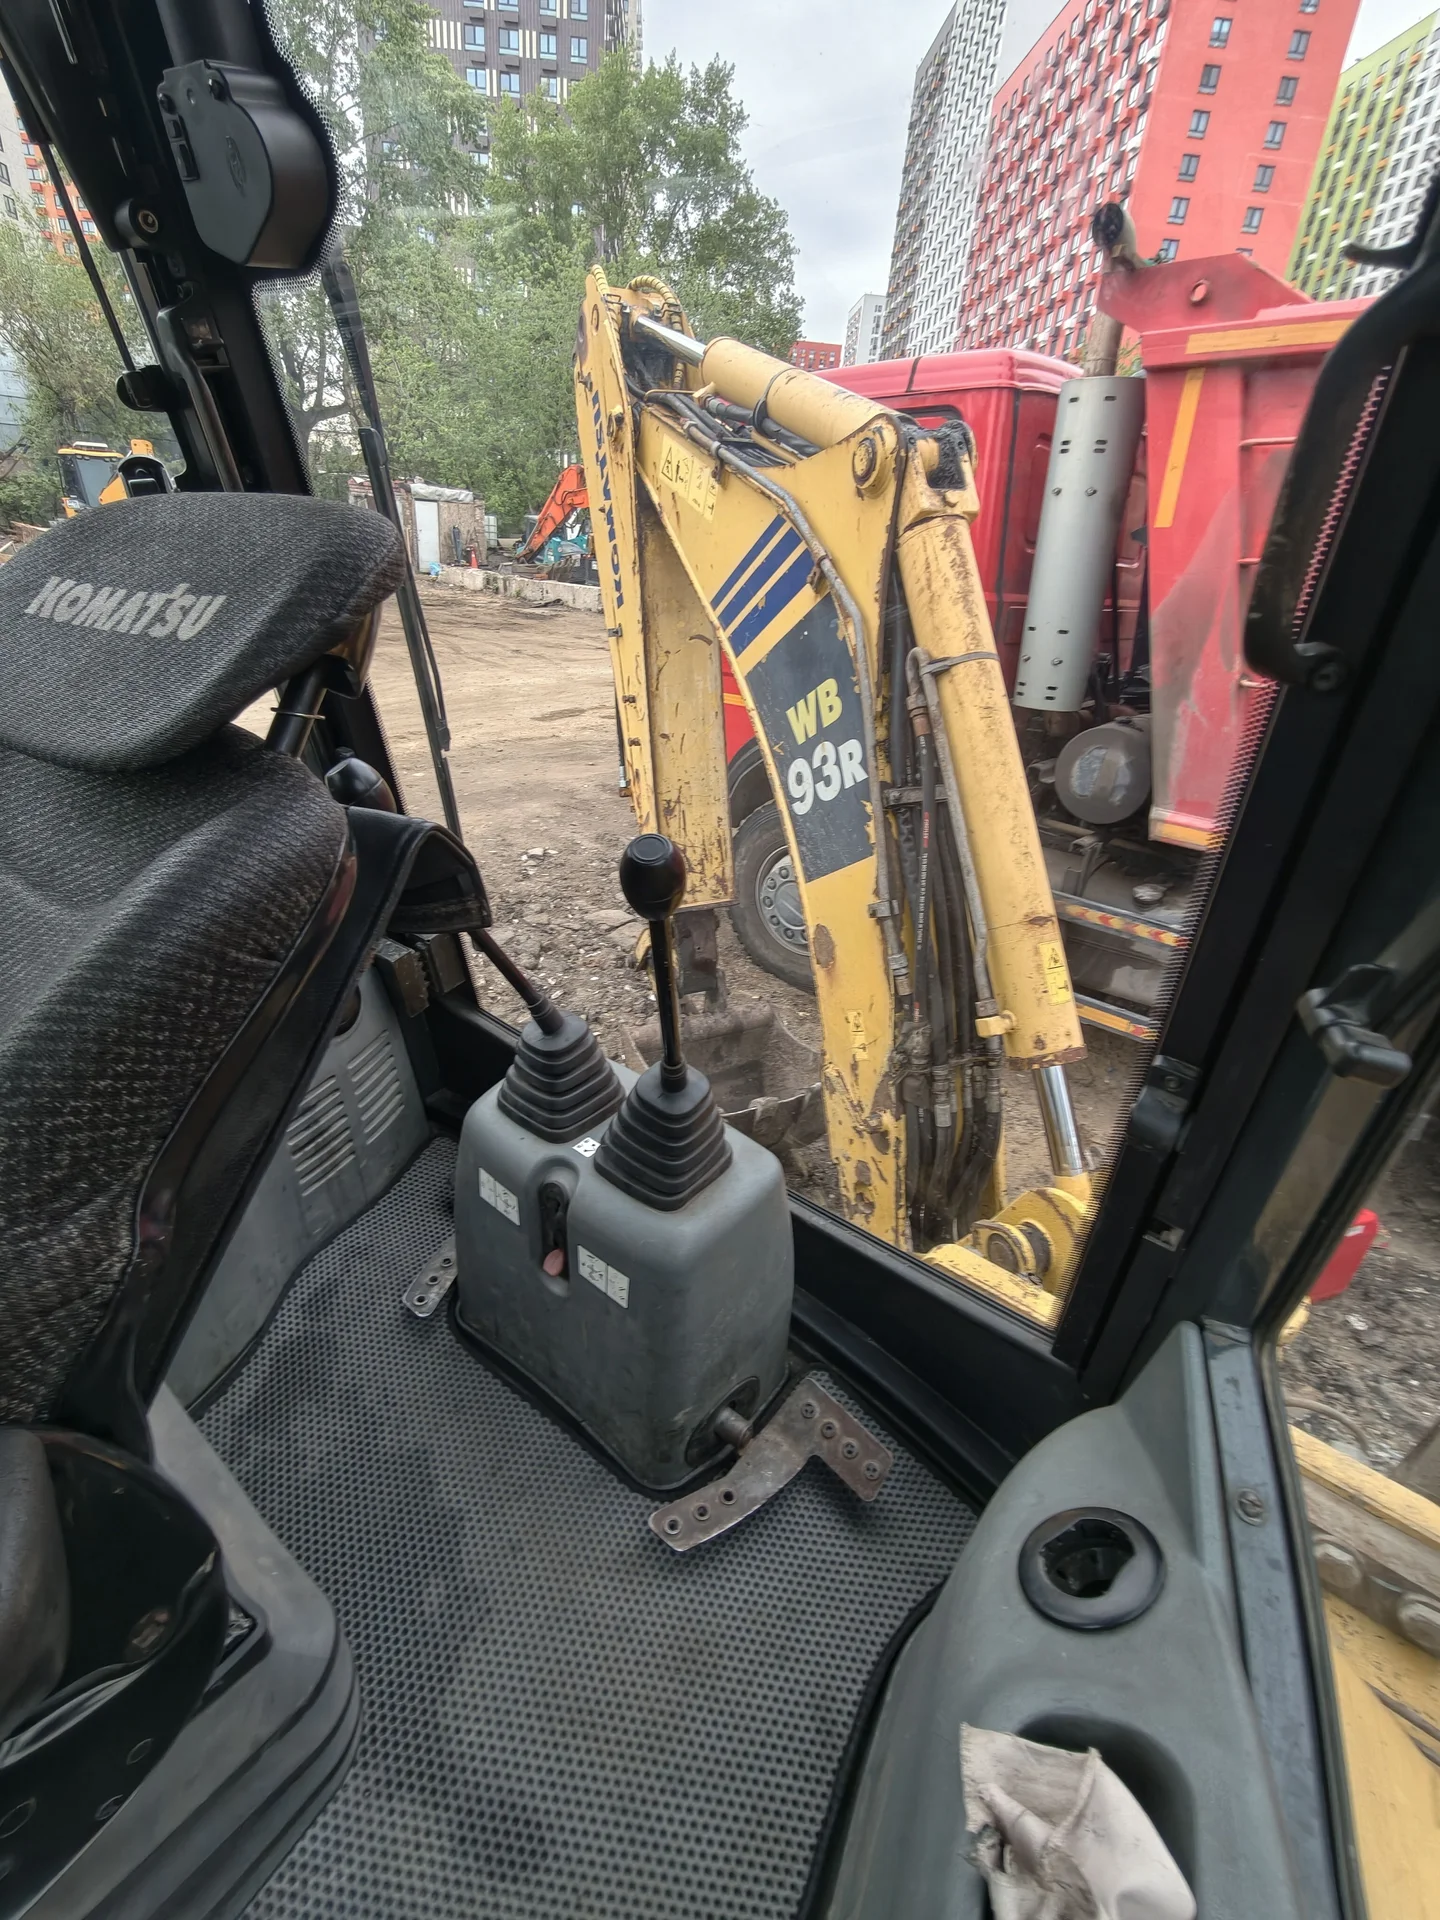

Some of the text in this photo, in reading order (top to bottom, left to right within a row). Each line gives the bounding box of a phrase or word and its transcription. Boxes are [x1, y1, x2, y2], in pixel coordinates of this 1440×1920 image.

[592, 390, 624, 609] KOMATSU
[24, 576, 227, 641] KOMATSU
[785, 678, 843, 745] WB
[787, 739, 869, 815] 93R
